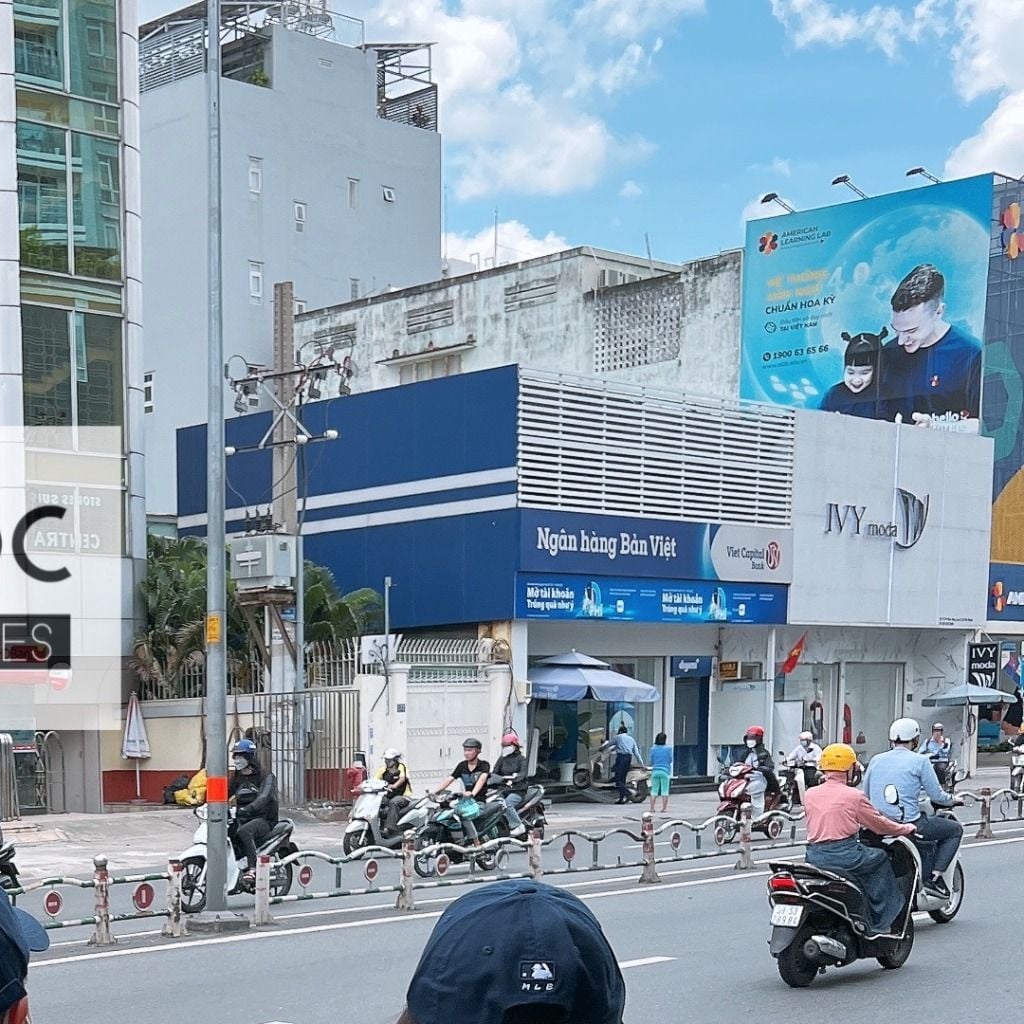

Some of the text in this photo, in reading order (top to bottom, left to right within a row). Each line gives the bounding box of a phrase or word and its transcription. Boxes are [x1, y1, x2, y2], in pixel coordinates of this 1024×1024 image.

[781, 226, 818, 238] AMERICAN
[780, 234, 816, 246] LEARNING
[817, 231, 831, 239] LAB
[800, 299, 821, 310] HOA
[773, 344, 829, 360] 1900 63 65 66
[931, 411, 959, 422] hello
[825, 502, 898, 538] IVY moda
[537, 527, 677, 561] Ngân hàng Bản Việt
[726, 545, 765, 563] Viet Capital
[751, 561, 765, 570] Bank
[971, 647, 996, 659] IVY
[971, 661, 996, 669] moda
[522, 983, 553, 991] MLB
